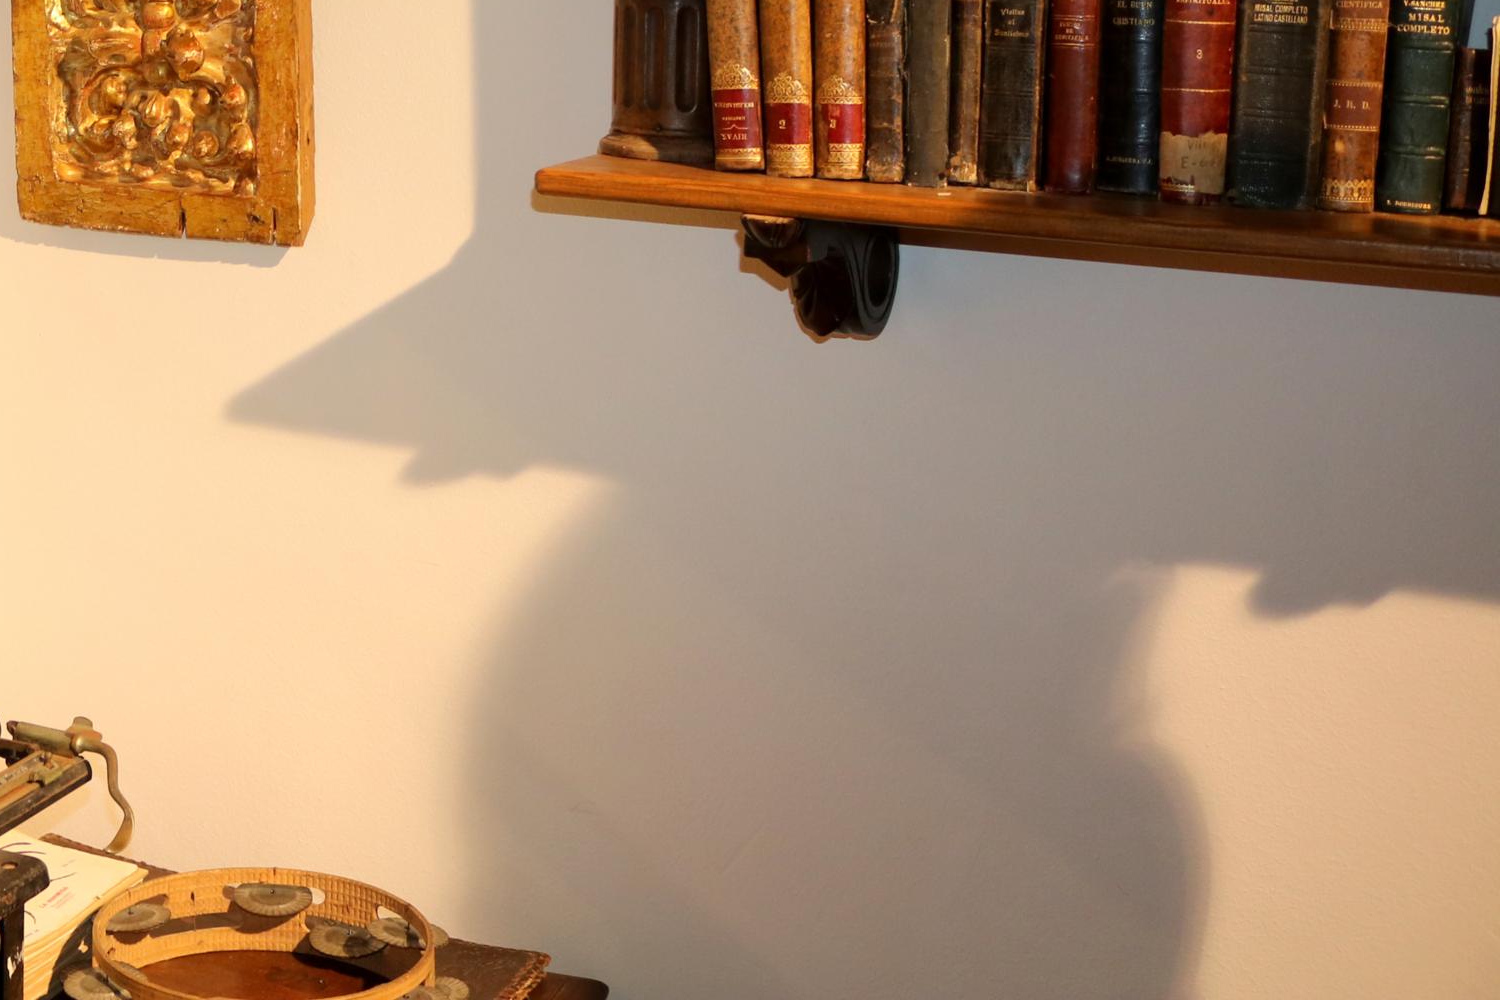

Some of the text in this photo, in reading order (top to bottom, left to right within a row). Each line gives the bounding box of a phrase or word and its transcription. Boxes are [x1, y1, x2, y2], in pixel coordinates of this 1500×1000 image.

[1117, 0, 1153, 9] EL BUEN
[1254, 3, 1309, 15] MISAL COMPLETO
[1336, 0, 1383, 9] CIENTIFICA
[1112, 17, 1156, 26] CRISTIANO
[1253, 13, 1309, 25] LATINO CASTELLANO
[1409, 13, 1445, 23] MISAL
[1397, 24, 1450, 35] COMPLETO
[1196, 49, 1204, 60] 3
[778, 119, 787, 130] 2
